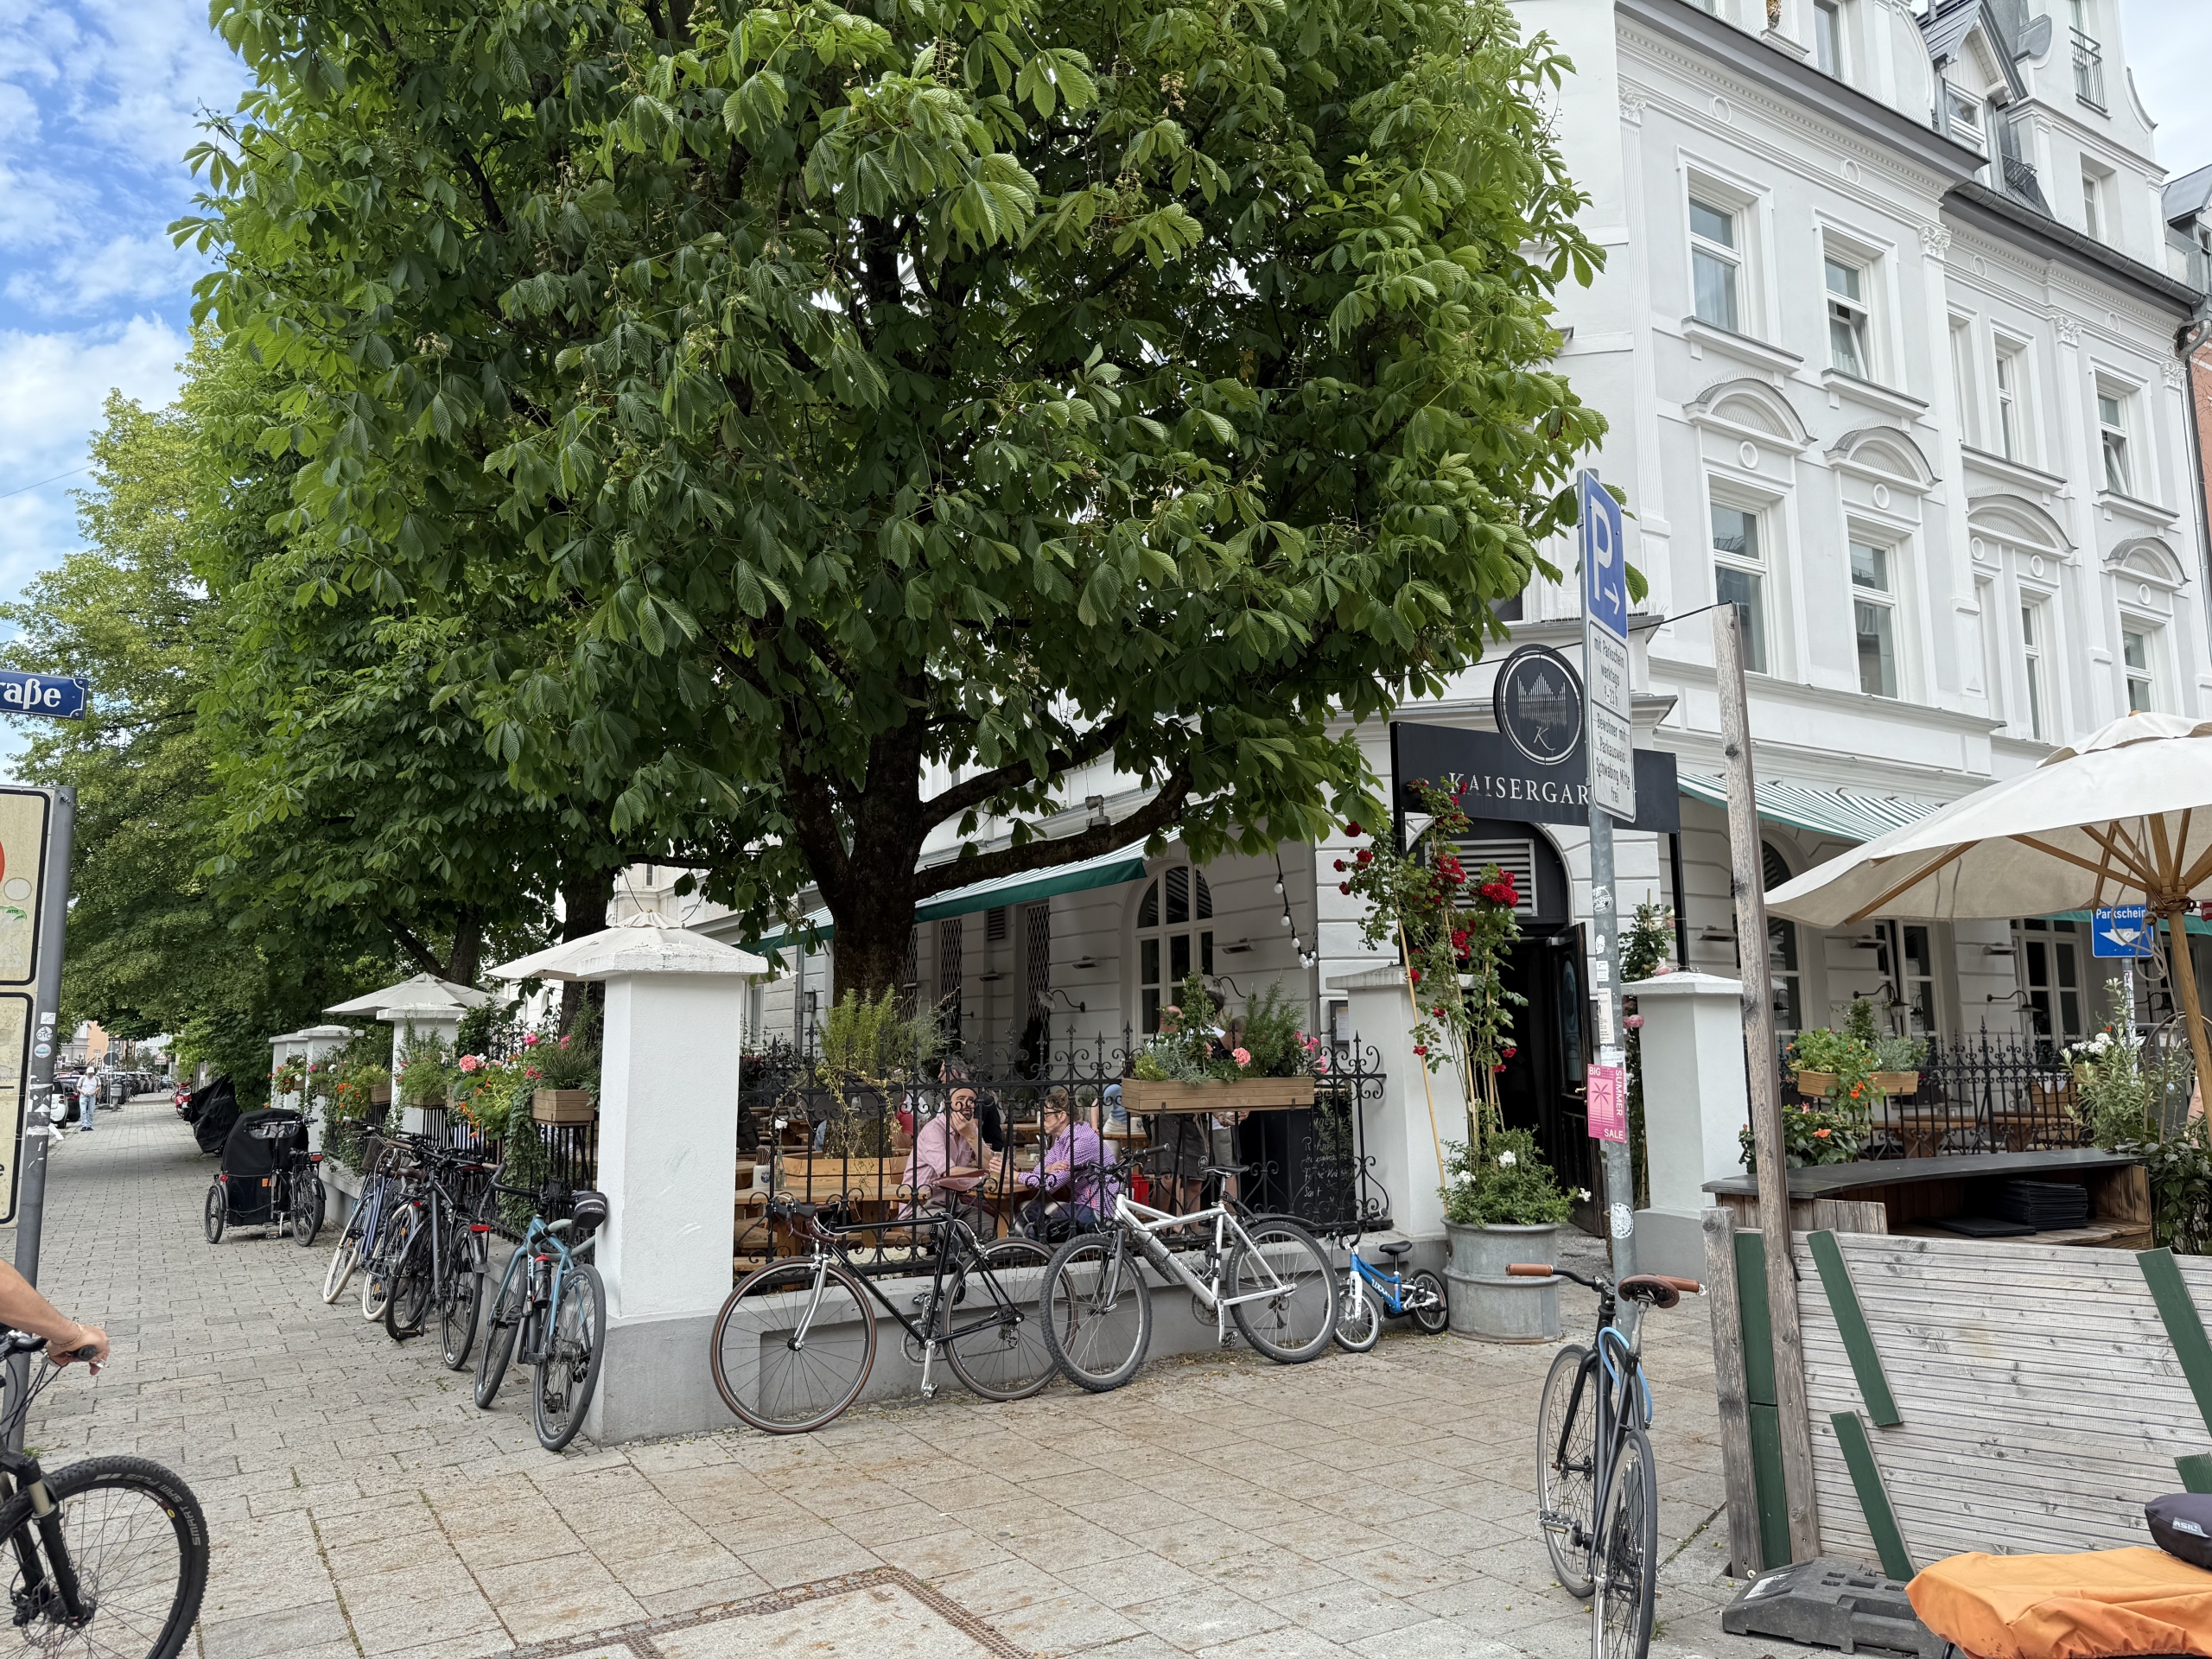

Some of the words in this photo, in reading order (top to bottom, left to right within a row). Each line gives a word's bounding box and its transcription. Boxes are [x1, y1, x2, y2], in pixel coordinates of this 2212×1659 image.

[1591, 494, 1612, 601] P
[1603, 639, 1624, 669] Parkschein
[1600, 663, 1619, 690] werktags
[1597, 712, 1618, 738] Bewohner
[1599, 735, 1625, 764] Parkausweis
[1596, 757, 1618, 785] Schwabing
[1620, 767, 1630, 790] Mitte
[1448, 772, 1590, 805] KAISERGAR
[1589, 1066, 1601, 1076] BIG
[1604, 1128, 1624, 1140] SALE
[125, 1473, 160, 1486] PLUS
[158, 1484, 183, 1503] SAM
[179, 1505, 201, 1546] SMART
